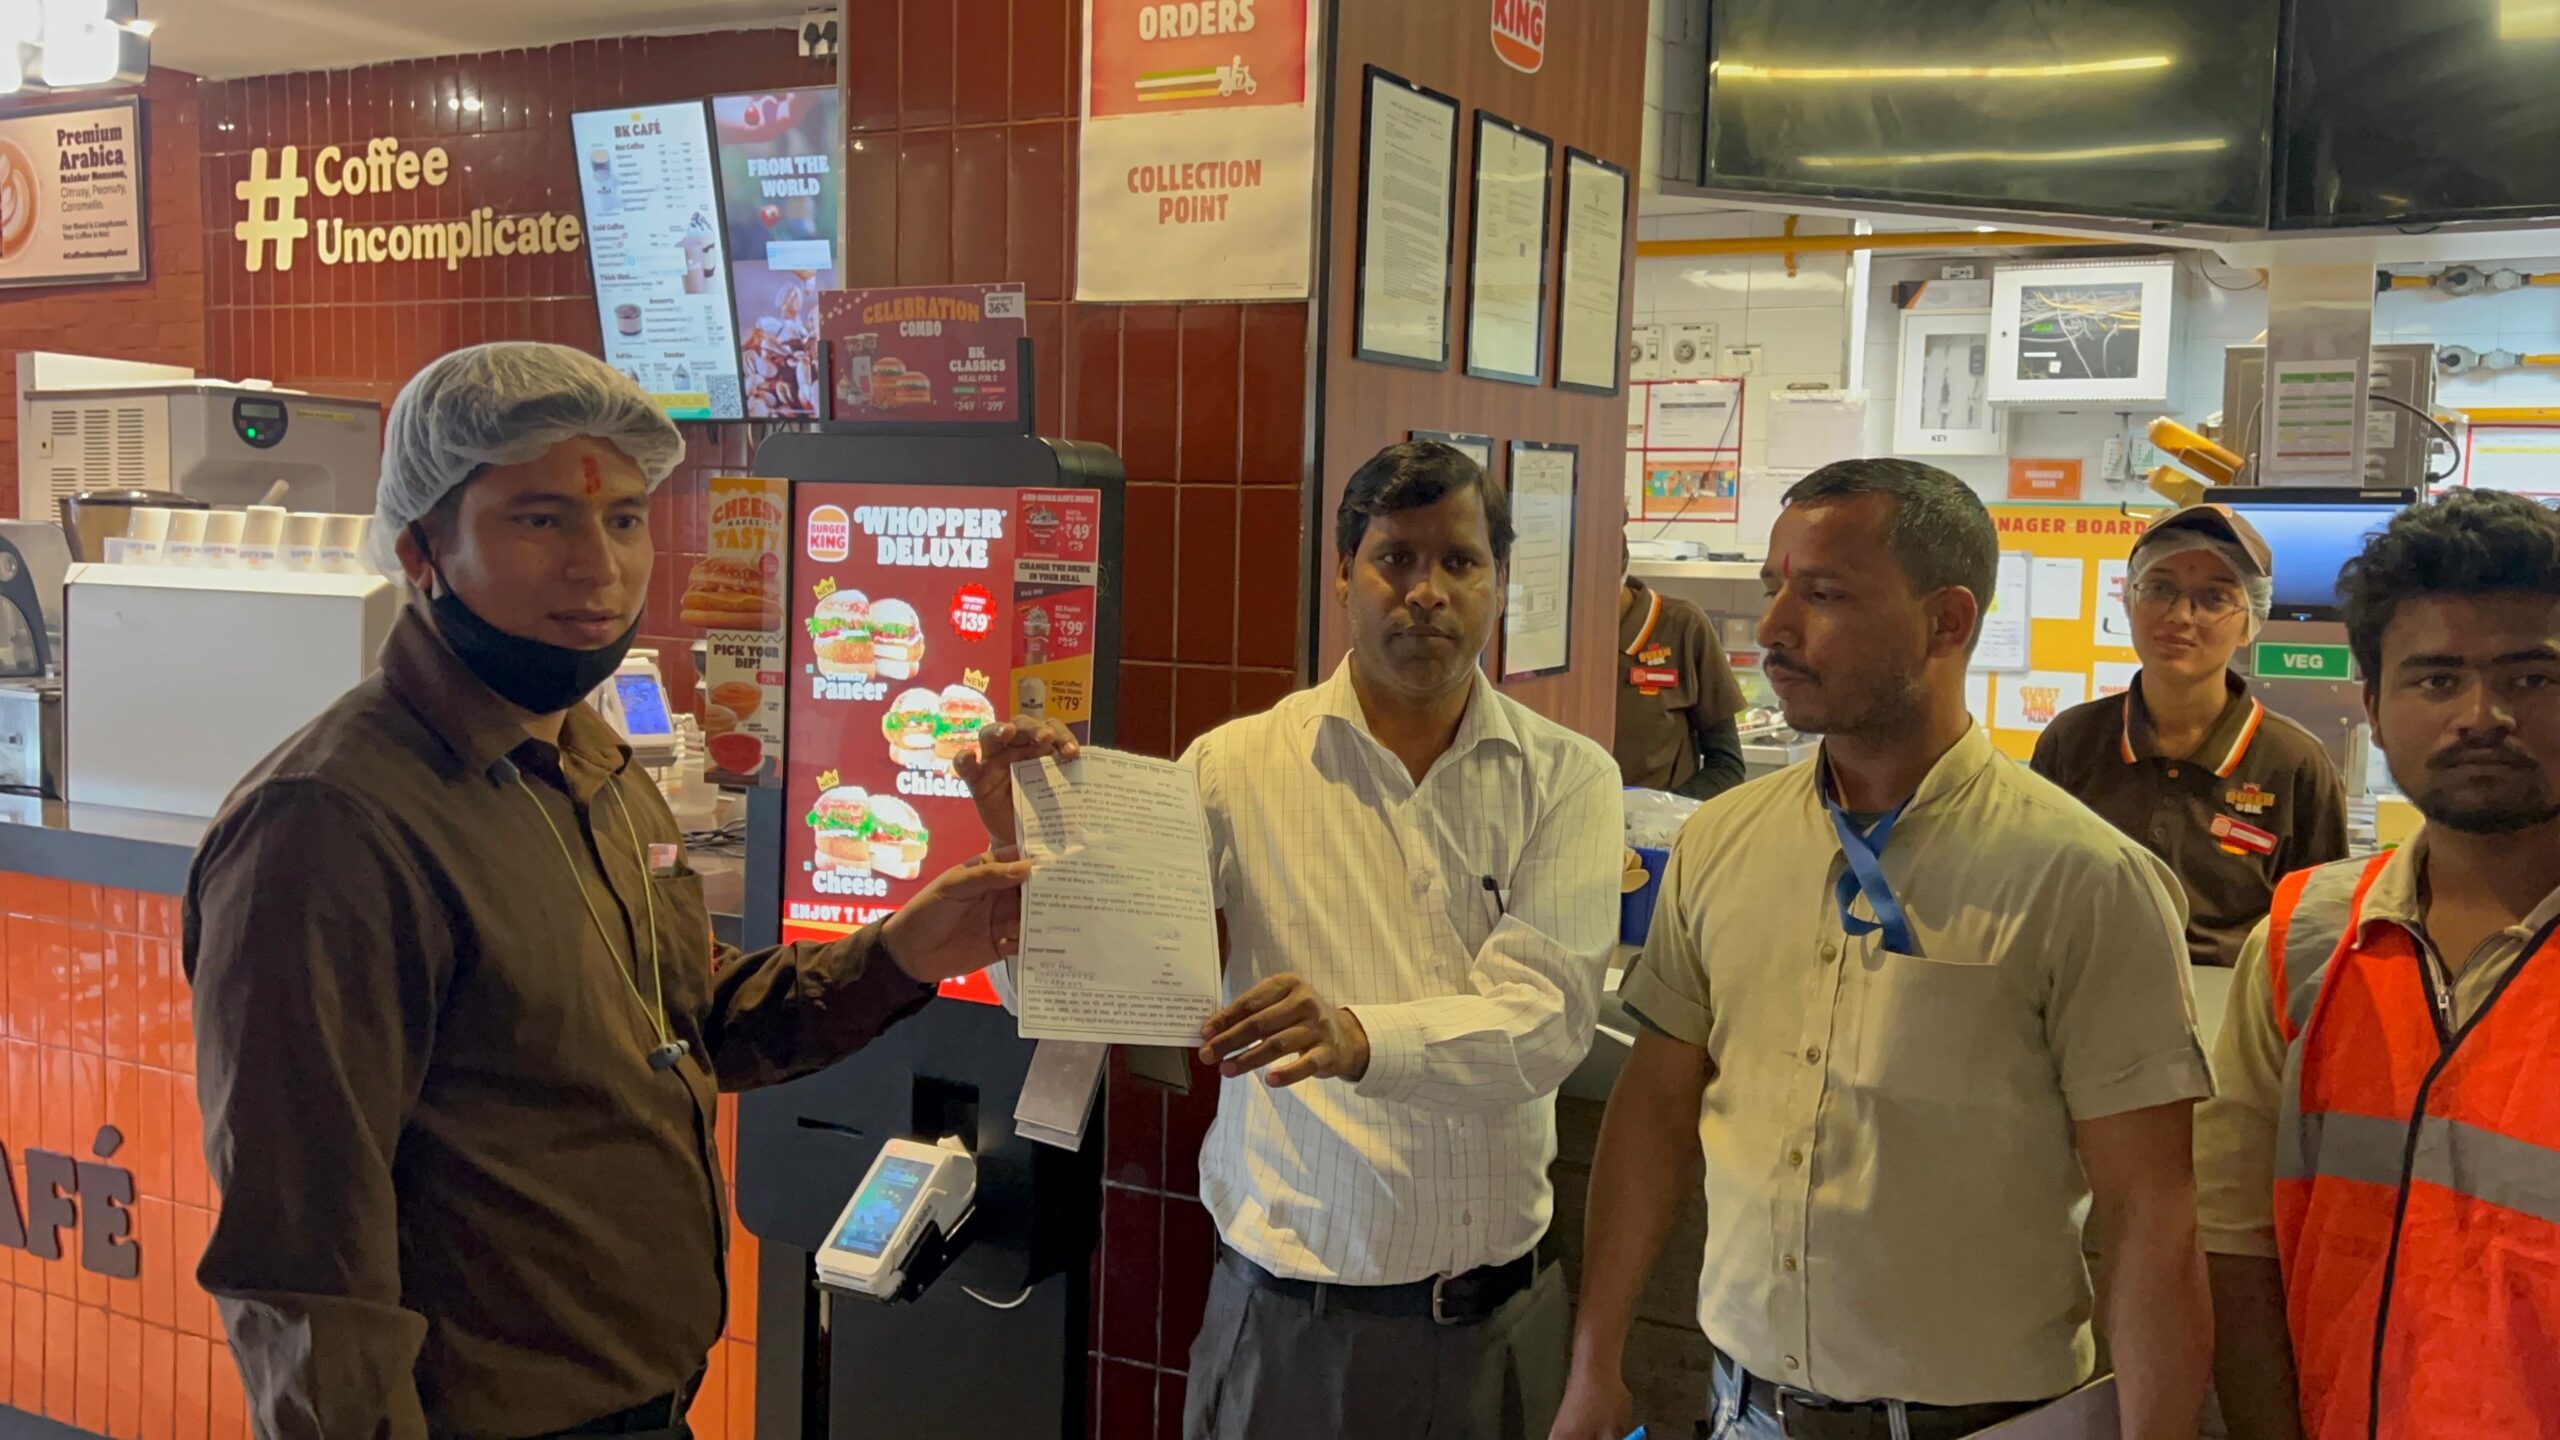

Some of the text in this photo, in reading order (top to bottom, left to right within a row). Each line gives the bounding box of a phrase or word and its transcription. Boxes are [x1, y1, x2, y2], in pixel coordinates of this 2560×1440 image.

[1138, 0, 1256, 41] ORDERS
[1493, 0, 1544, 47] KING
[57, 123, 123, 147] Premium
[614, 118, 662, 138] BK CAFÉ
[315, 137, 449, 196] Coffee
[747, 155, 830, 177] FROM THE
[1127, 160, 1262, 194] COLLECTION
[761, 178, 820, 198] WORLD
[1159, 194, 1229, 225] POINT
[316, 207, 584, 271] Uncomplicate
[862, 295, 981, 324] CELEBRATION
[899, 320, 942, 337] COMBO
[968, 346, 985, 358] BK
[949, 360, 1006, 372] CLASSICS
[712, 496, 782, 527] CHEESY
[811, 523, 846, 534] BURGER
[1997, 517, 2066, 534] NAGER
[713, 526, 780, 552] TASTY
[810, 534, 846, 549] KING
[877, 536, 989, 569] DELUXE
[1019, 562, 1051, 571] CHANGE
[1052, 564, 1067, 572] THE
[1039, 573, 1059, 581] YOUR
[1060, 574, 1080, 582] MEAL
[816, 583, 835, 597] NEW
[713, 644, 780, 659] PICK YOUR
[2283, 653, 2324, 670] VEG
[735, 657, 761, 669] DIP!
[813, 677, 888, 701] Paneer
[964, 675, 987, 690] NEW
[820, 774, 838, 788] NEW
[896, 771, 973, 798] Chicke
[812, 870, 888, 898] Cheese
[790, 903, 842, 921] ENJOY
